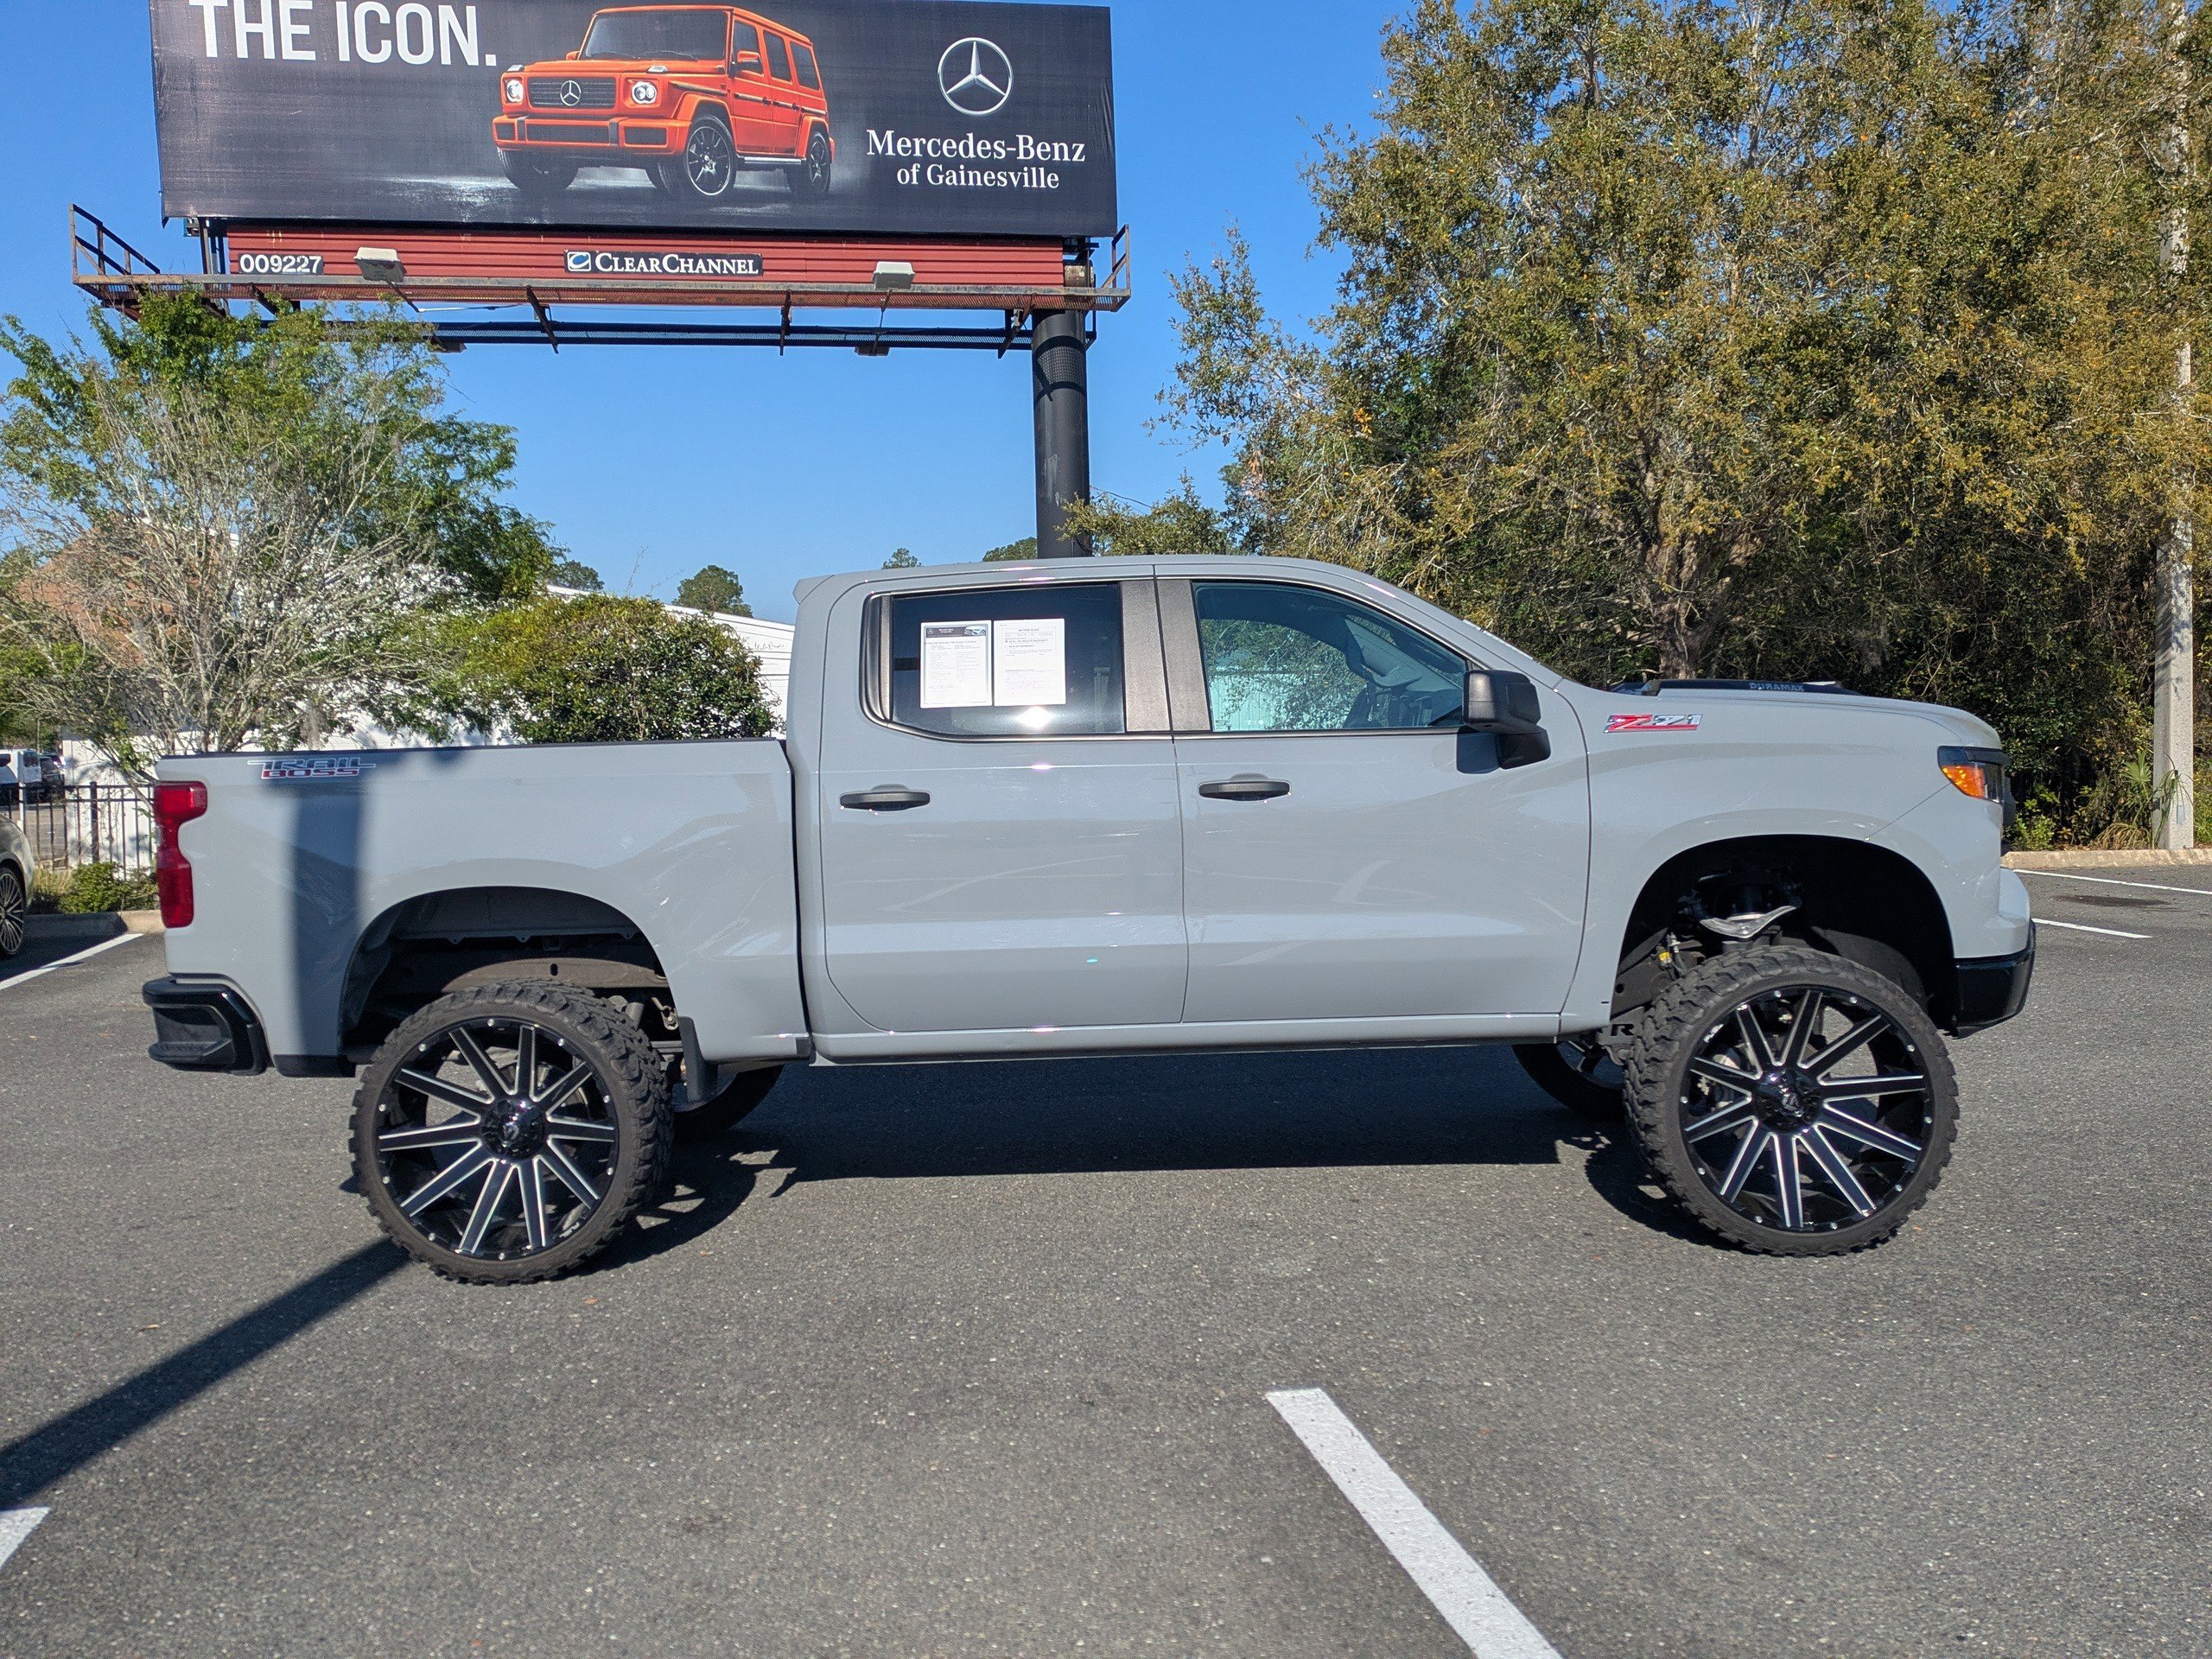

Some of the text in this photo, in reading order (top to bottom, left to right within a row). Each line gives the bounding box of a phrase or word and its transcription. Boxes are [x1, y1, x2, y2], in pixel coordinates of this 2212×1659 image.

[188, 0, 497, 67] THE ICON.
[866, 130, 1086, 162] Mercedes-Benz
[896, 163, 1060, 189] of Gainesville
[239, 254, 321, 273] 009227
[1749, 682, 1805, 692] DURAMAX
[1604, 714, 1703, 733] Z71
[247, 757, 376, 769] TRAIL
[261, 767, 359, 779] BOSS
